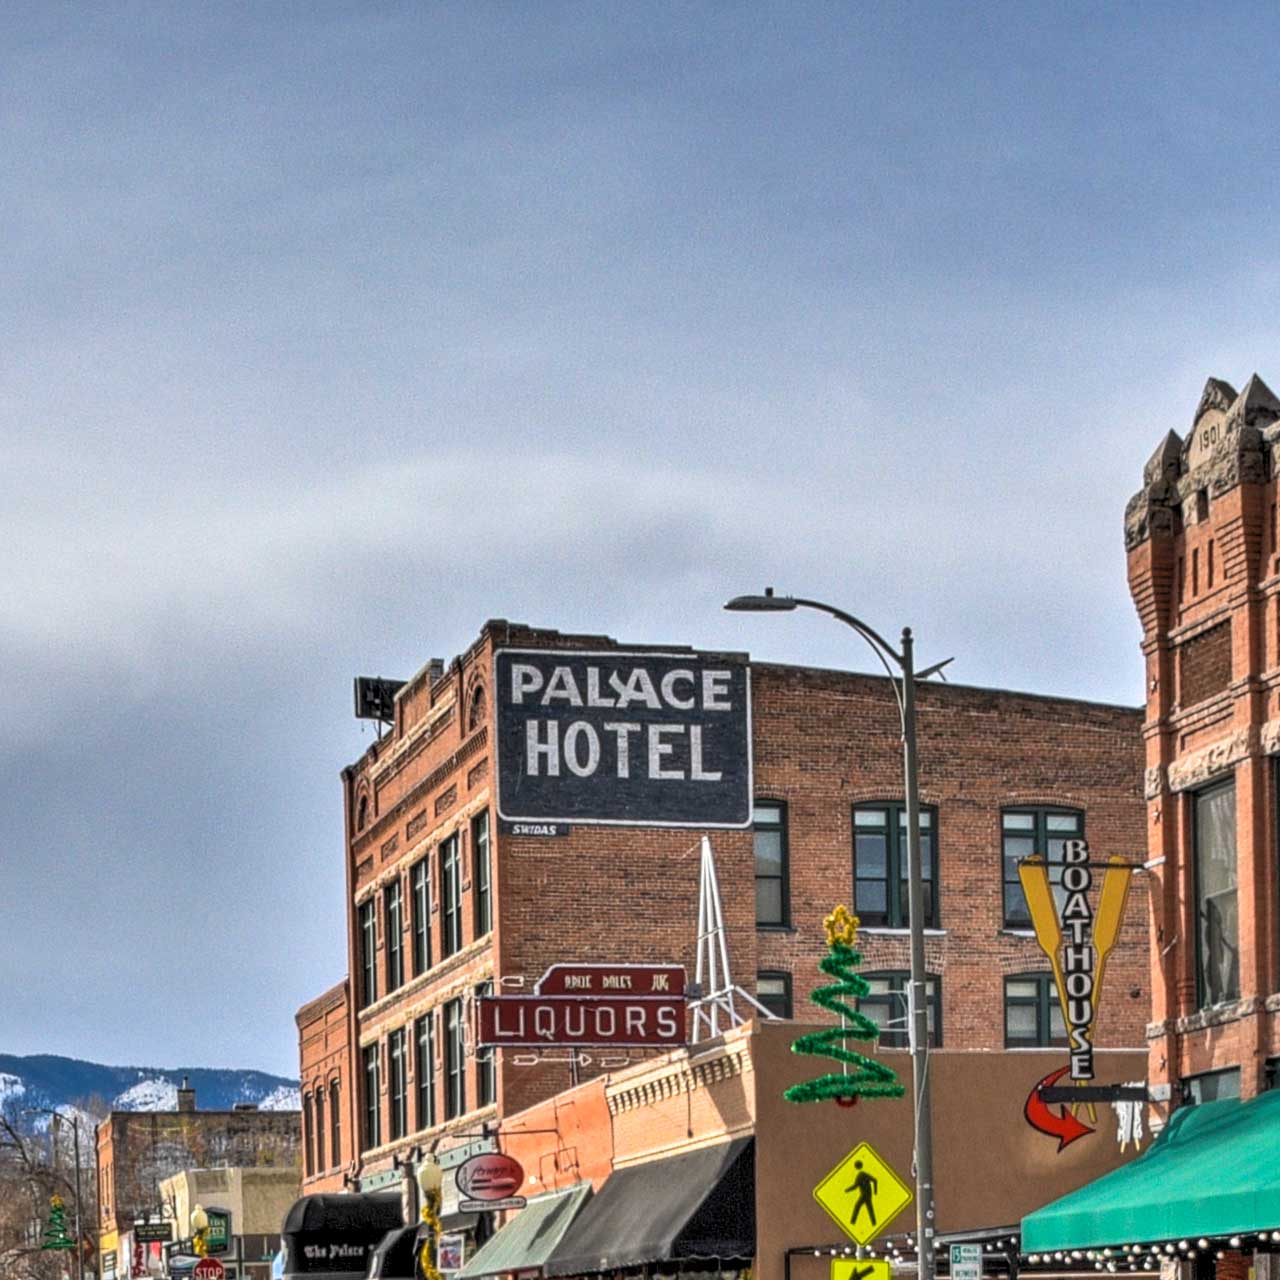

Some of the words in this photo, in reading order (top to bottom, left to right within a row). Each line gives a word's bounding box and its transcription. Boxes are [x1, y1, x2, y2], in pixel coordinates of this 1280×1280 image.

[511, 663, 732, 711] PALACE
[525, 719, 722, 781] HOTEL
[1063, 839, 1093, 1079] BOATHOUSE
[651, 973, 669, 991] JUG
[494, 1005, 678, 1040] LIQUORS
[304, 1245, 327, 1259] The
[195, 1267, 222, 1280] STOP
